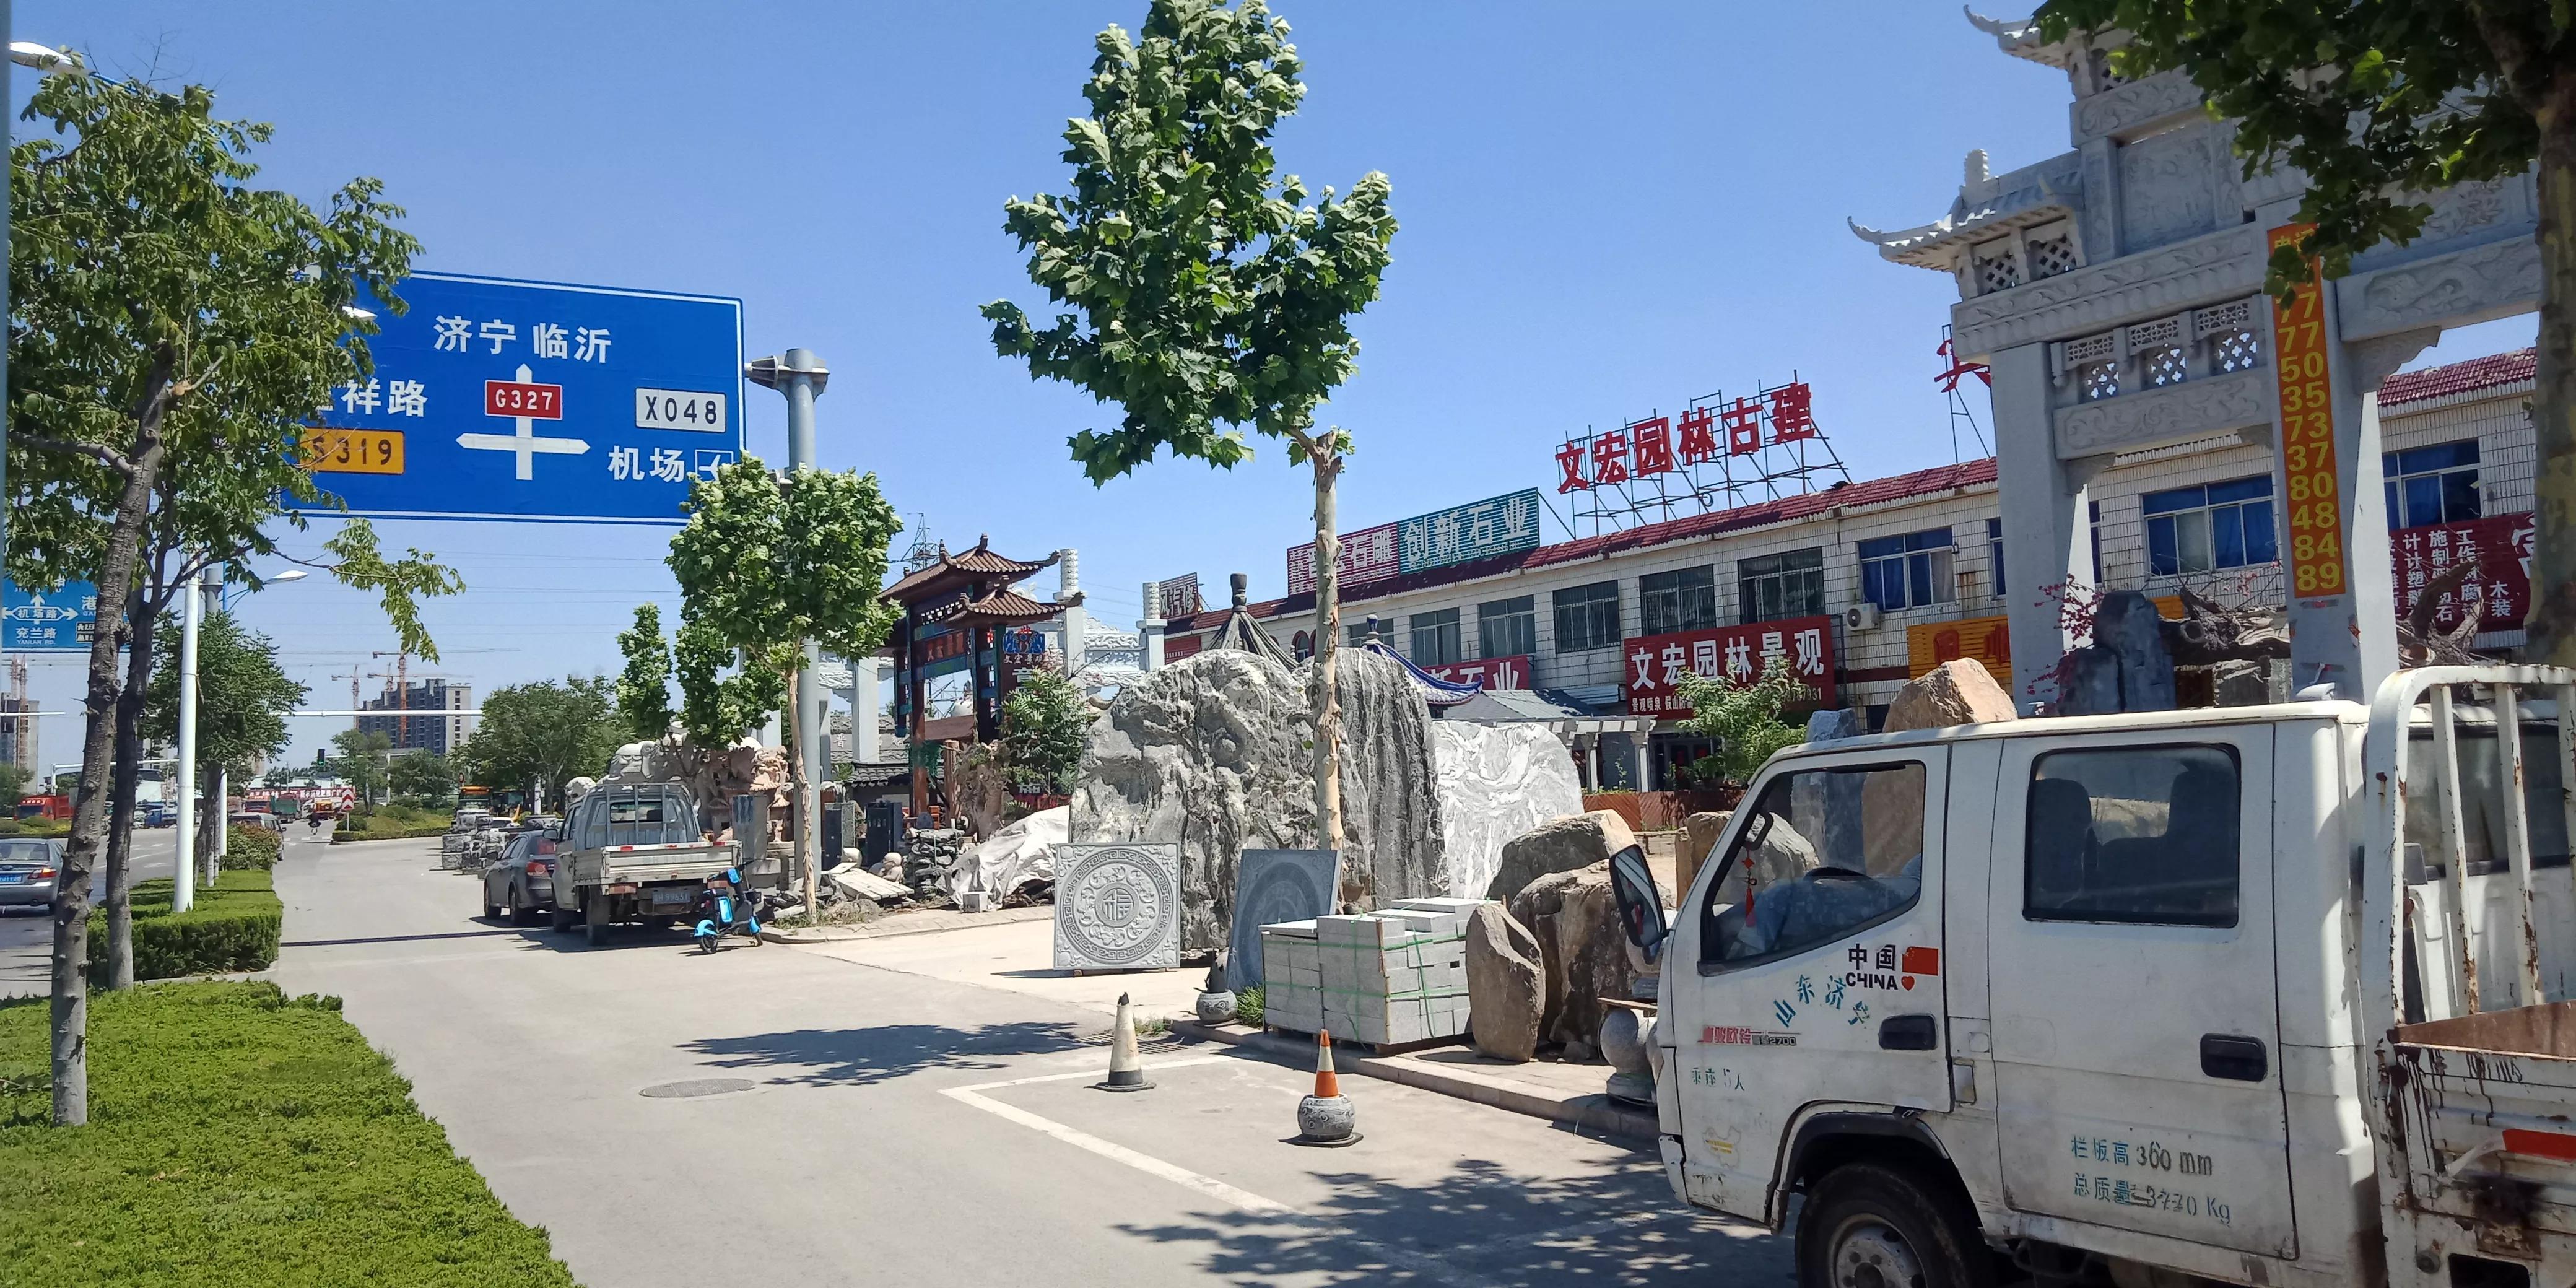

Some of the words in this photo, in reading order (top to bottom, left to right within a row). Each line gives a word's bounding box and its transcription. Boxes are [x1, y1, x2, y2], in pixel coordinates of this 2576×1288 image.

[433, 315, 516, 355] 济宁
[533, 323, 612, 363] 临沂
[315, 377, 428, 417] 祥路
[495, 389, 553, 411] G327
[645, 396, 717, 424] X048
[311, 436, 392, 466] S319
[1555, 382, 1815, 495] 文宏园林古建
[607, 445, 685, 482] 机场
[1404, 497, 1525, 562] 创新石业
[17, 608, 58, 619] 机场路
[15, 627, 57, 640] 兖兰路
[1630, 629, 1825, 692] 文宏园林景观
[1848, 943, 1896, 971] 中国
[1846, 972, 1898, 991] CHINA
[2071, 1134, 2130, 1166] 栏板高
[2137, 1141, 2172, 1172] 360
[2180, 1151, 2213, 1176] mm
